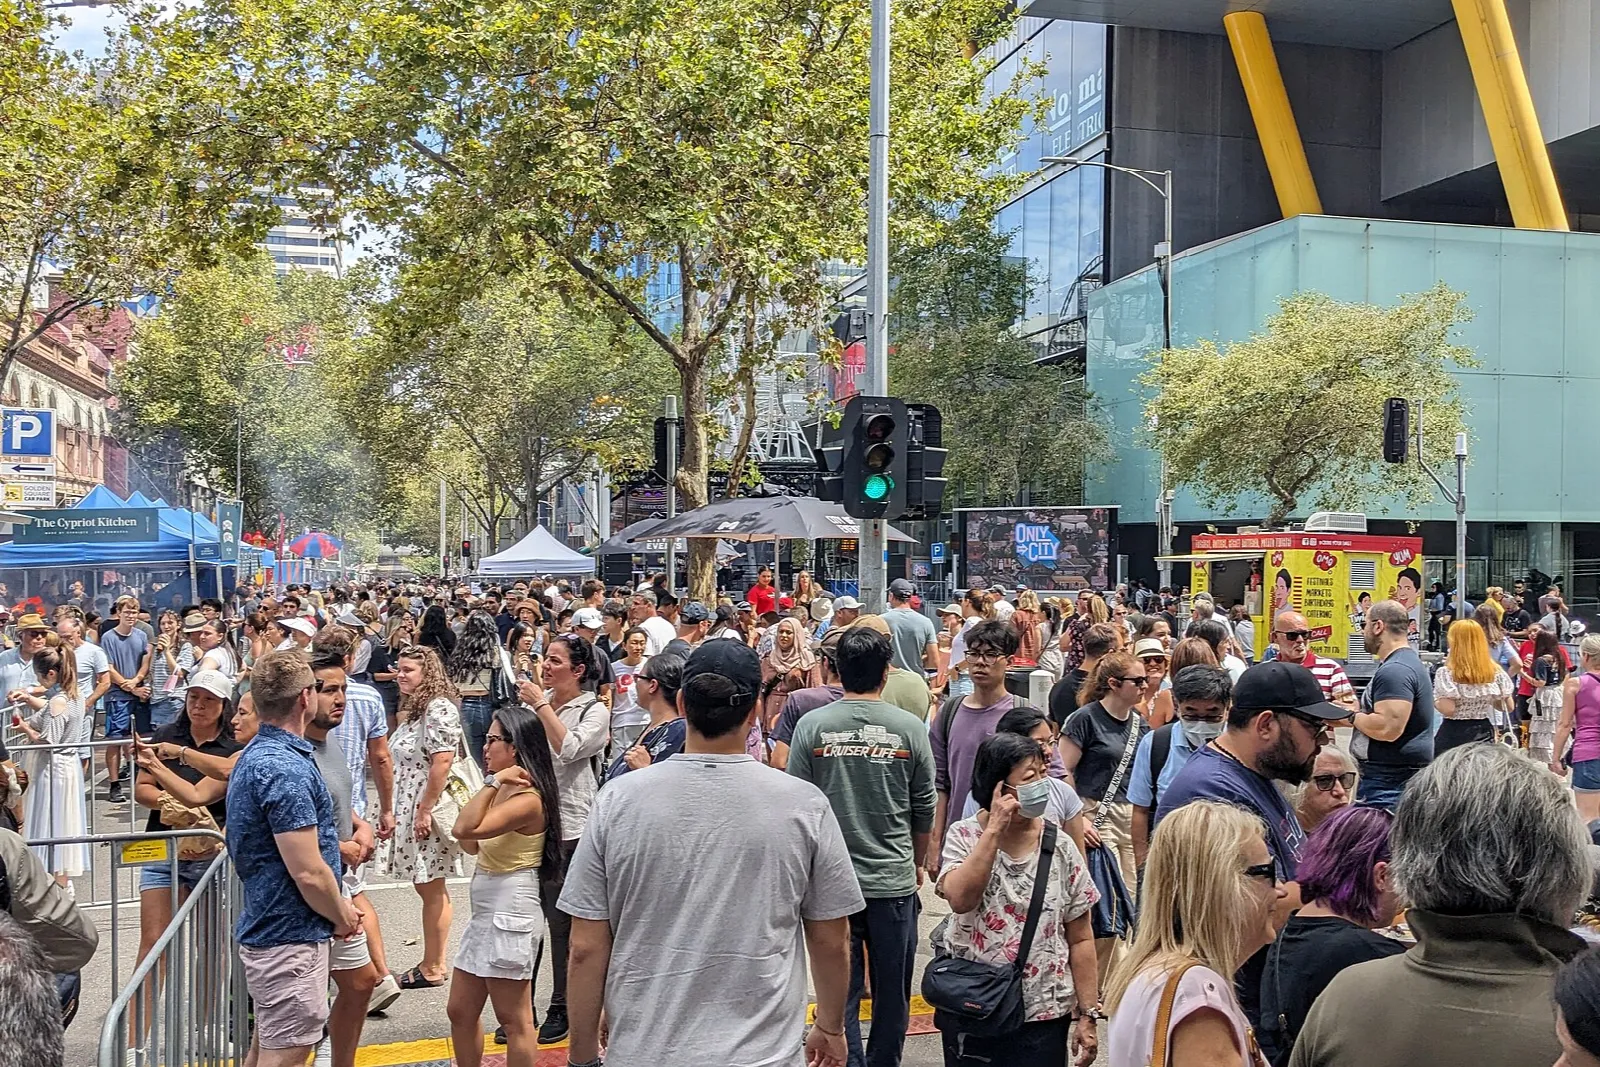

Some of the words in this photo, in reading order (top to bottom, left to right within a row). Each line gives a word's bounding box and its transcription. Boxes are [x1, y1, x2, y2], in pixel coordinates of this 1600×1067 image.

[12, 415, 42, 449] P
[35, 518, 56, 528] The
[57, 517, 96, 530] Cypriot
[97, 516, 137, 527] Kitchen
[1015, 523, 1051, 543] ONLY
[934, 546, 941, 556] P
[1029, 542, 1061, 562] CITY
[1393, 548, 1412, 564] YUM
[1317, 554, 1333, 566] OMG
[1307, 577, 1334, 586] FESTIVALS
[1305, 589, 1332, 598] MARKETS
[1304, 599, 1334, 607] BIRTHDAYS
[1306, 610, 1333, 618] CATERING
[1311, 630, 1328, 638] CALL
[822, 744, 869, 758] CRUISER
[870, 745, 897, 759] LIFE
